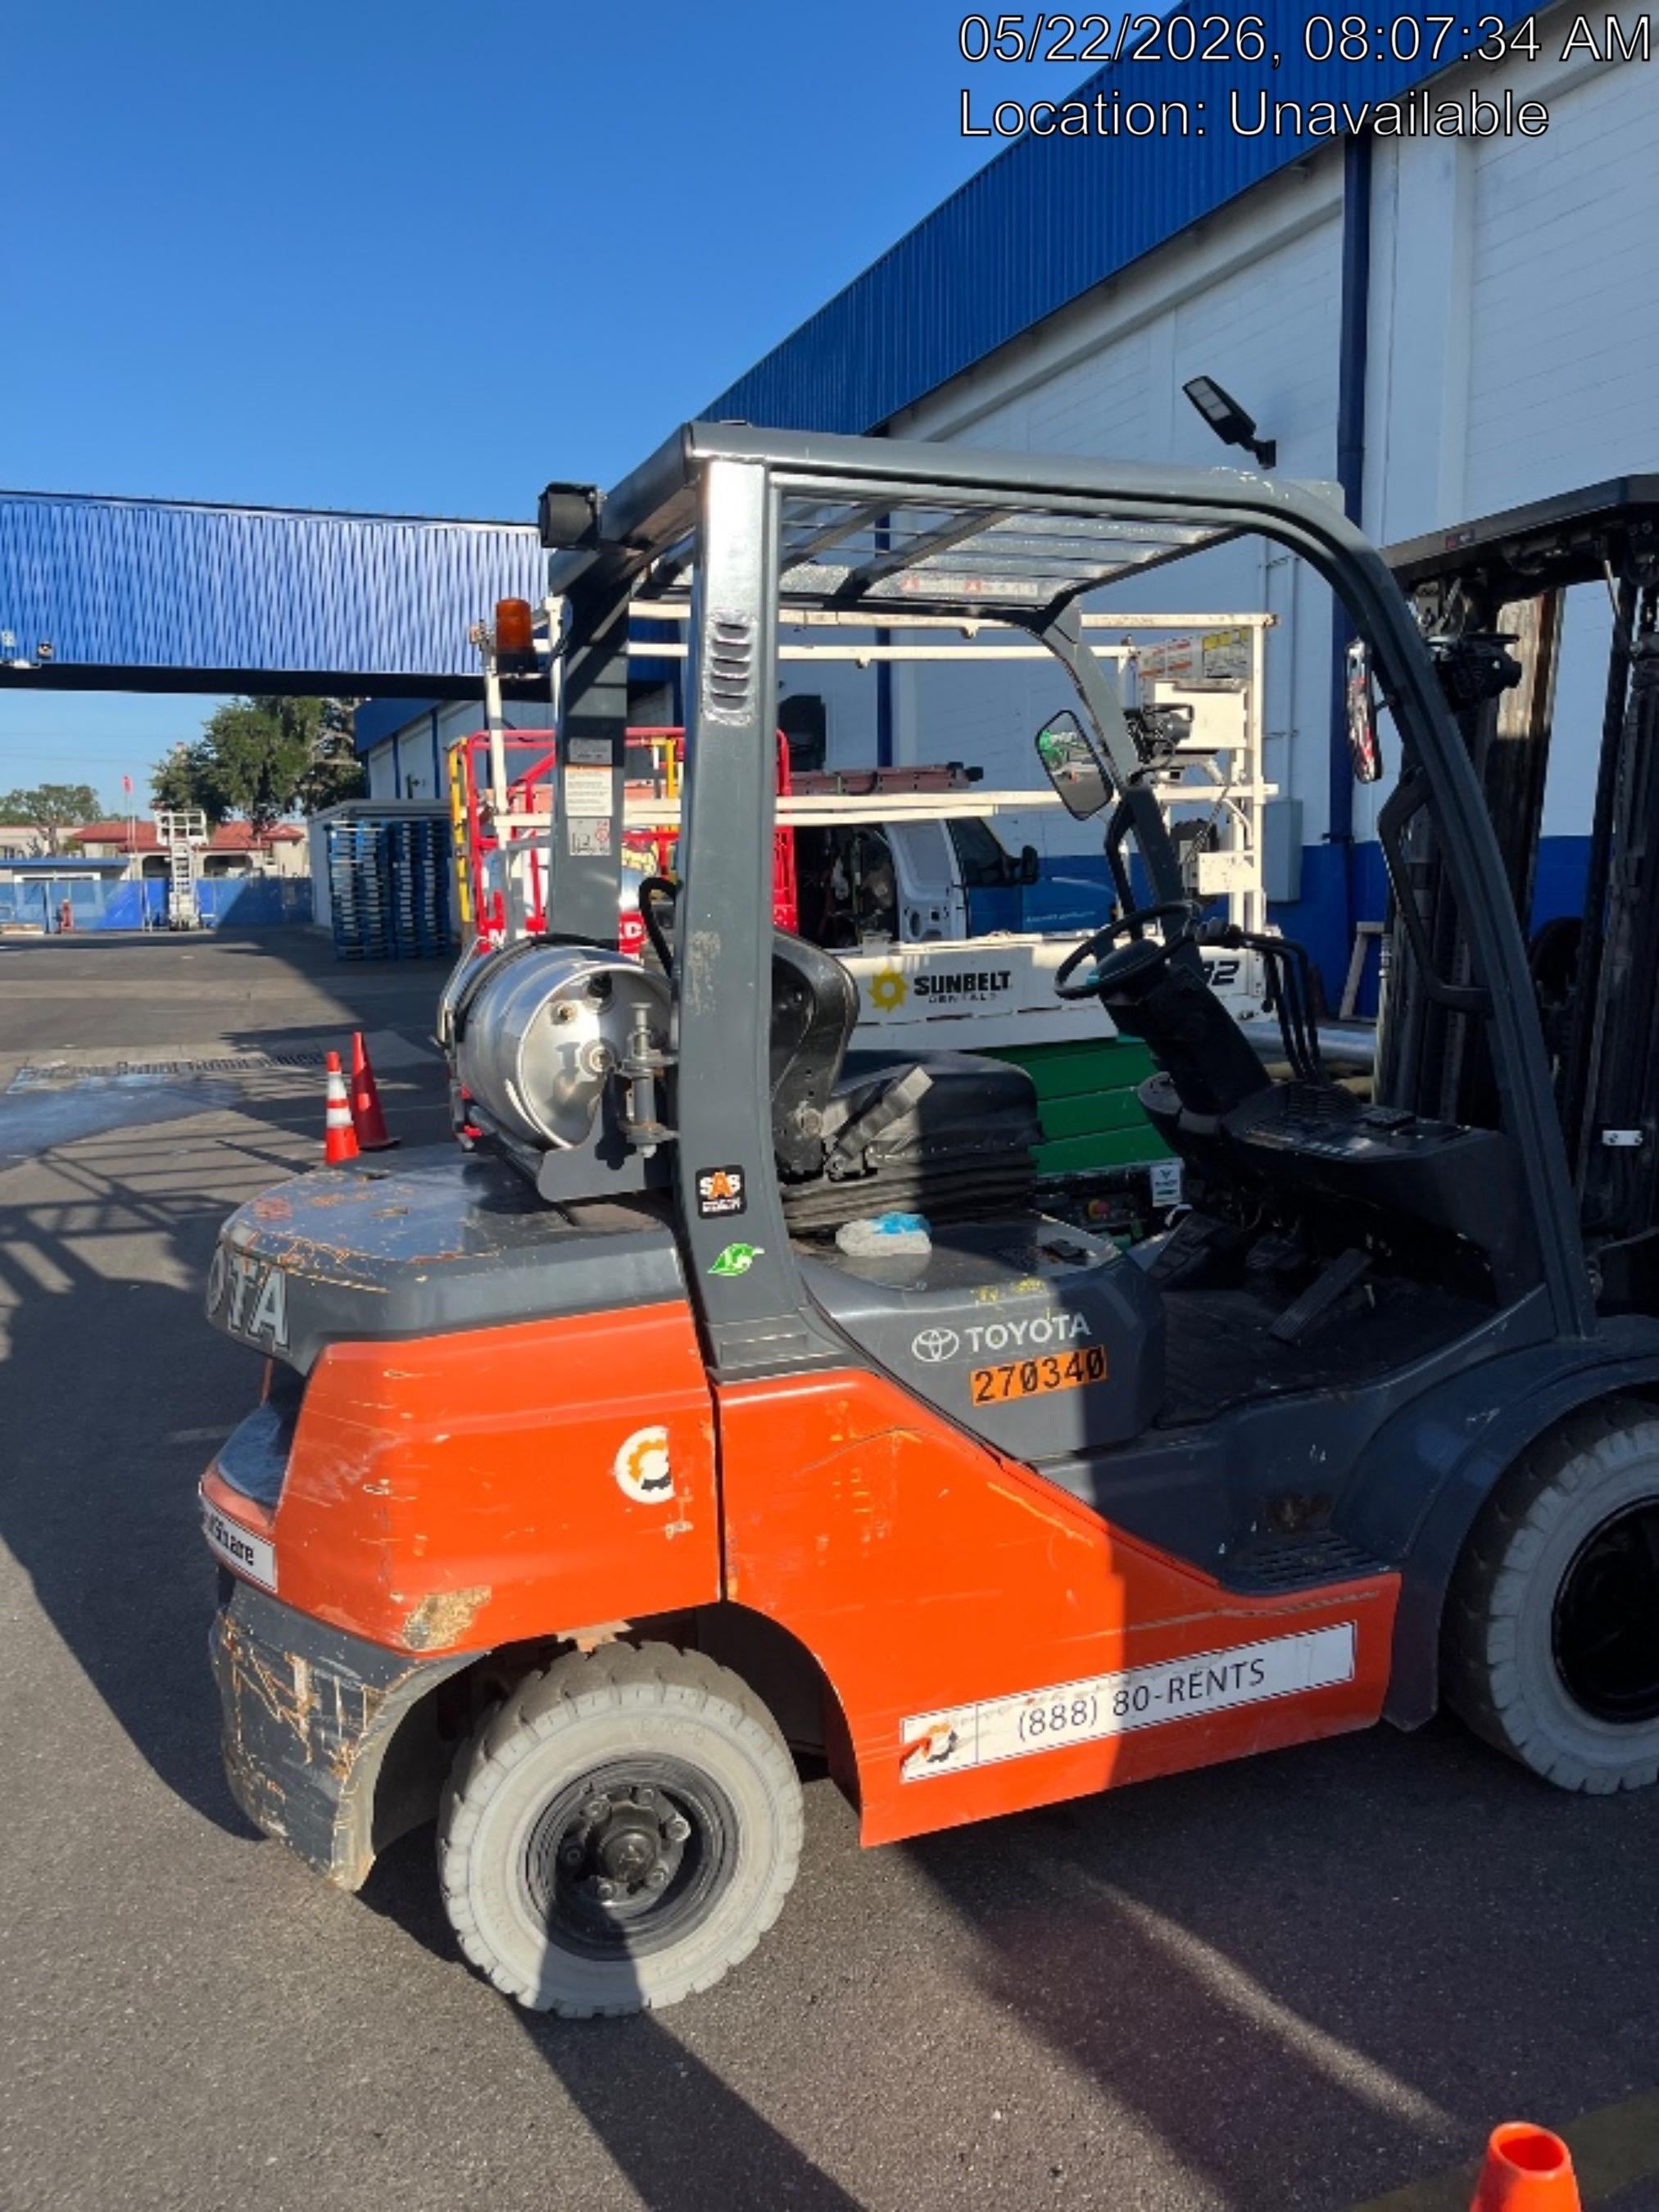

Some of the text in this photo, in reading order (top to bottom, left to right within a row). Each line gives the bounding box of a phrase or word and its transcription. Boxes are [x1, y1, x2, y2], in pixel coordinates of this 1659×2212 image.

[913, 970, 1012, 996] SUNBELT
[965, 1312, 1091, 1352] TOYOTA
[975, 1347, 1104, 1402] 270340
[1019, 1658, 1266, 1742] (888) 80-RENTS
